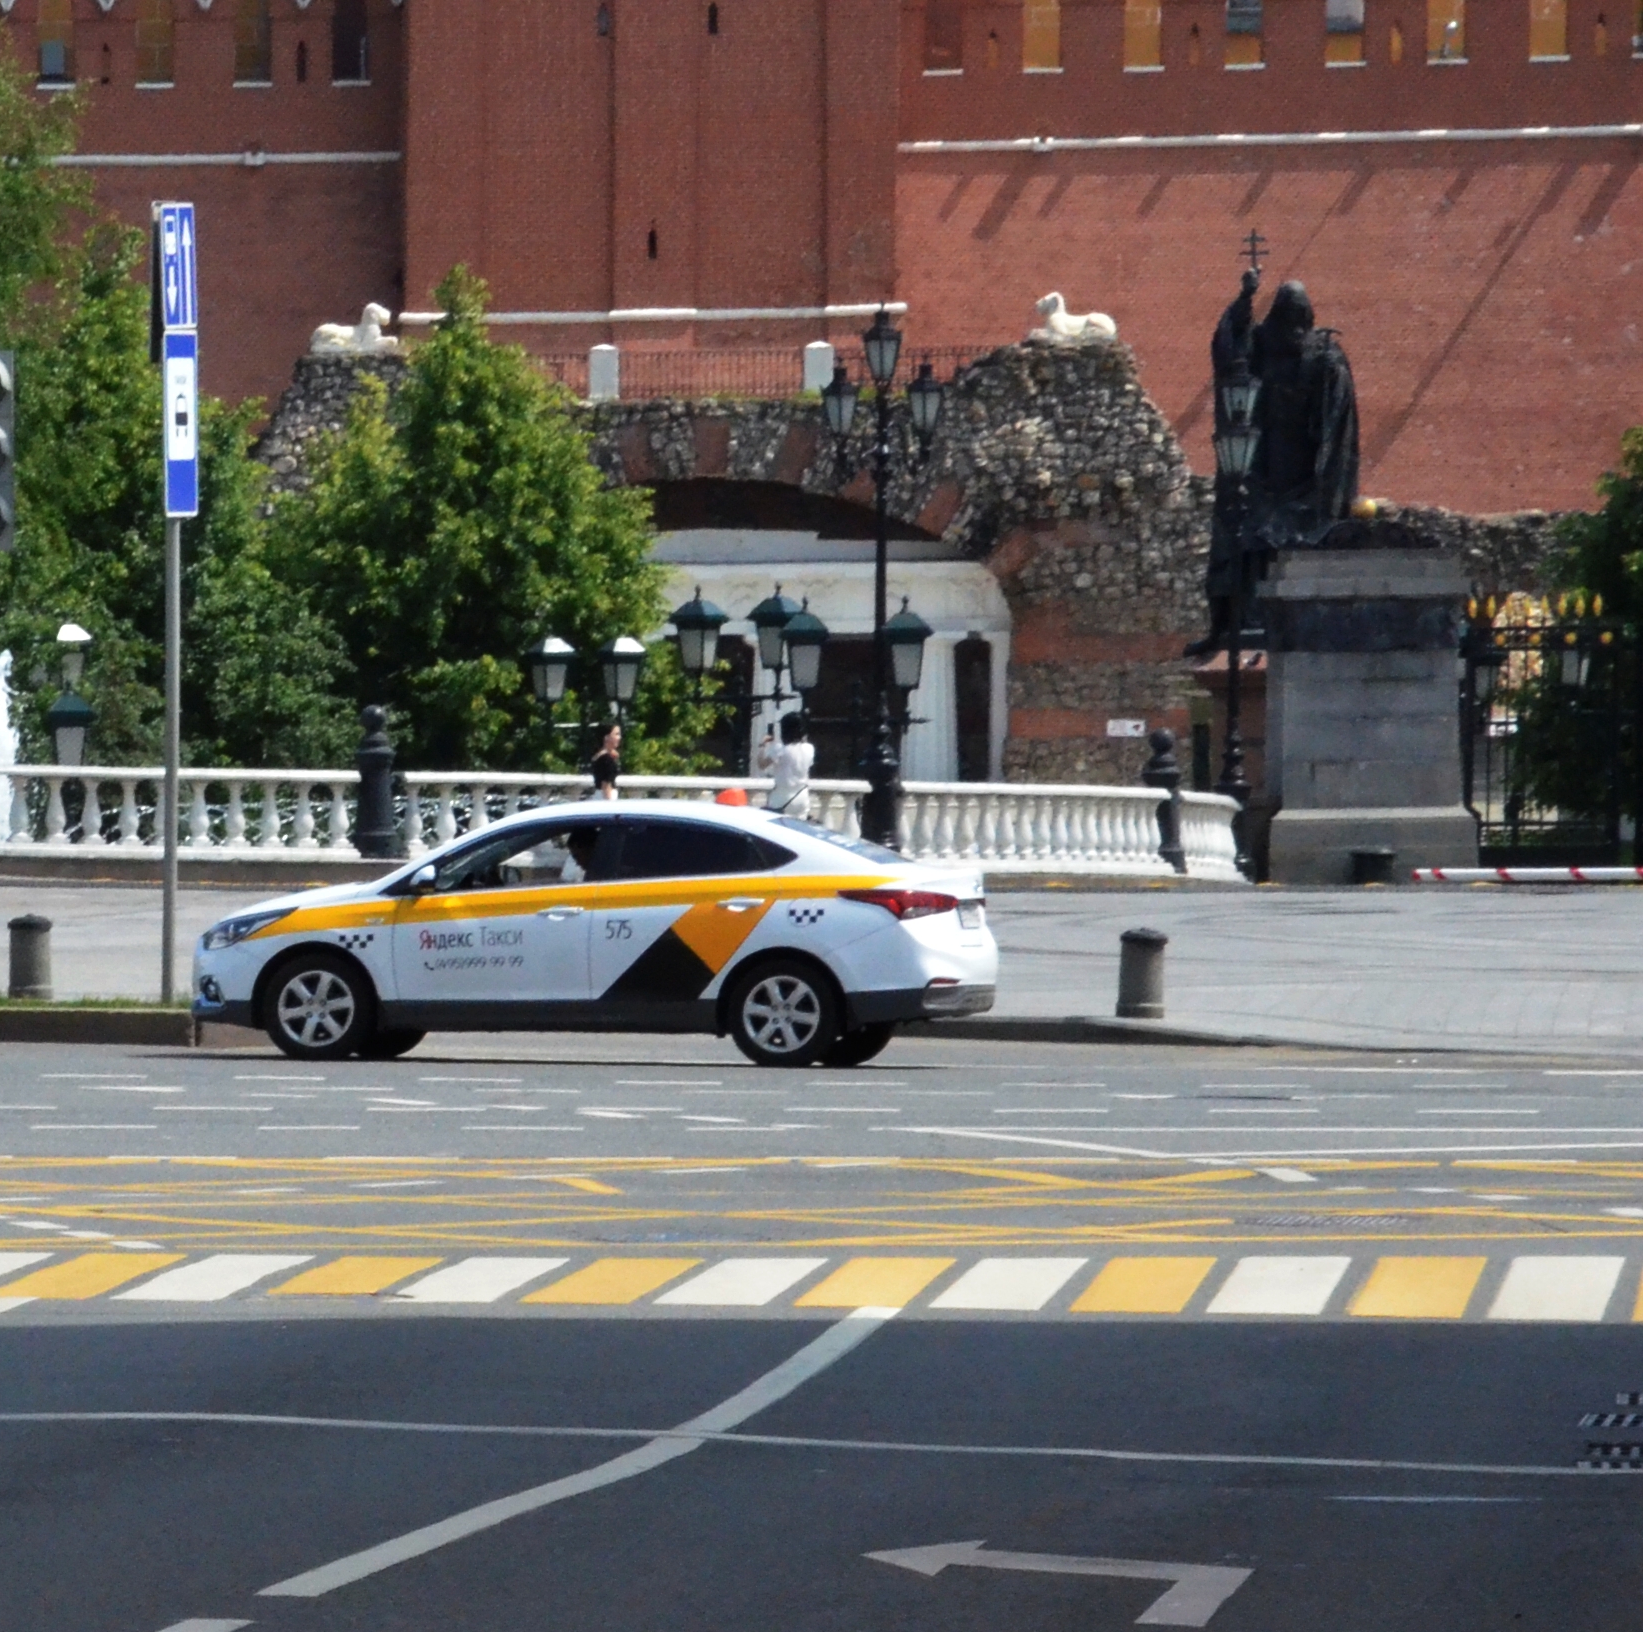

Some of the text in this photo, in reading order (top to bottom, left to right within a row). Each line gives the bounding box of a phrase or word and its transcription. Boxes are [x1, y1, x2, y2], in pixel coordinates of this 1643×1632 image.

[419, 926, 523, 950] Яндекс Такси
[605, 919, 633, 940] 575
